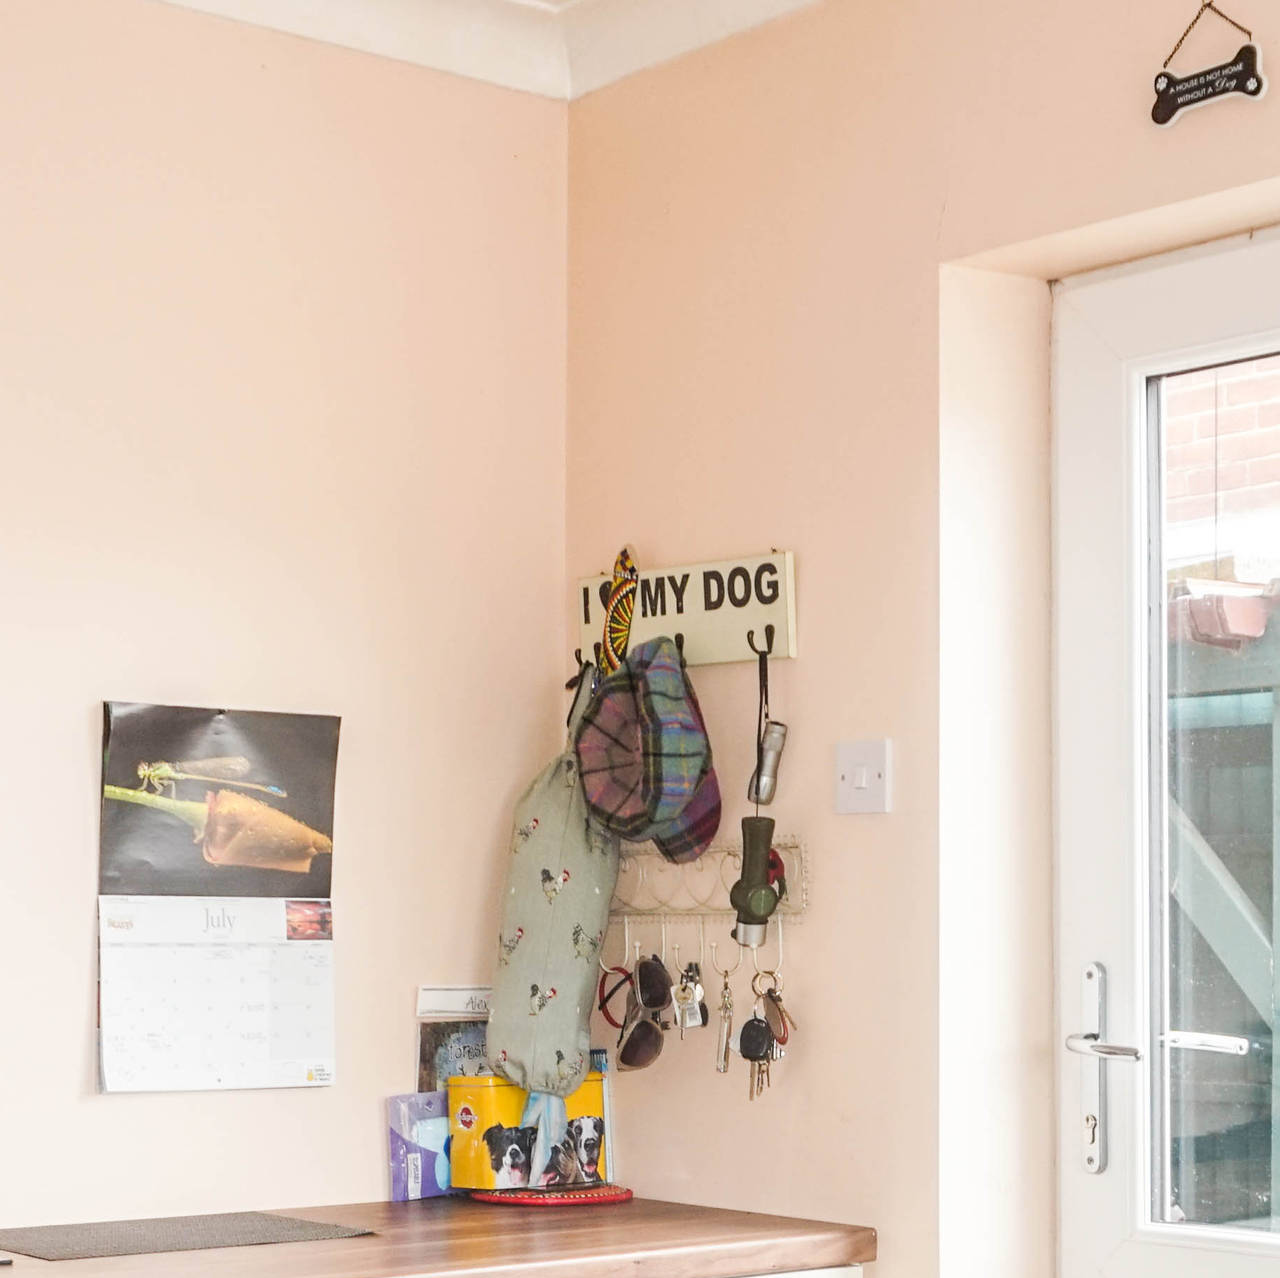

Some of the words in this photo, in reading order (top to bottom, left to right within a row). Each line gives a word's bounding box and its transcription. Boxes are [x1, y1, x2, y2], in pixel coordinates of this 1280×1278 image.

[1176, 79, 1197, 91] HOUSE
[1206, 70, 1221, 81] NOT
[1222, 63, 1243, 75] HOME
[1177, 88, 1205, 103] WITHOUT
[583, 587, 590, 624] I
[640, 573, 690, 618] MY
[703, 563, 779, 611] DOG
[203, 908, 236, 933] July
